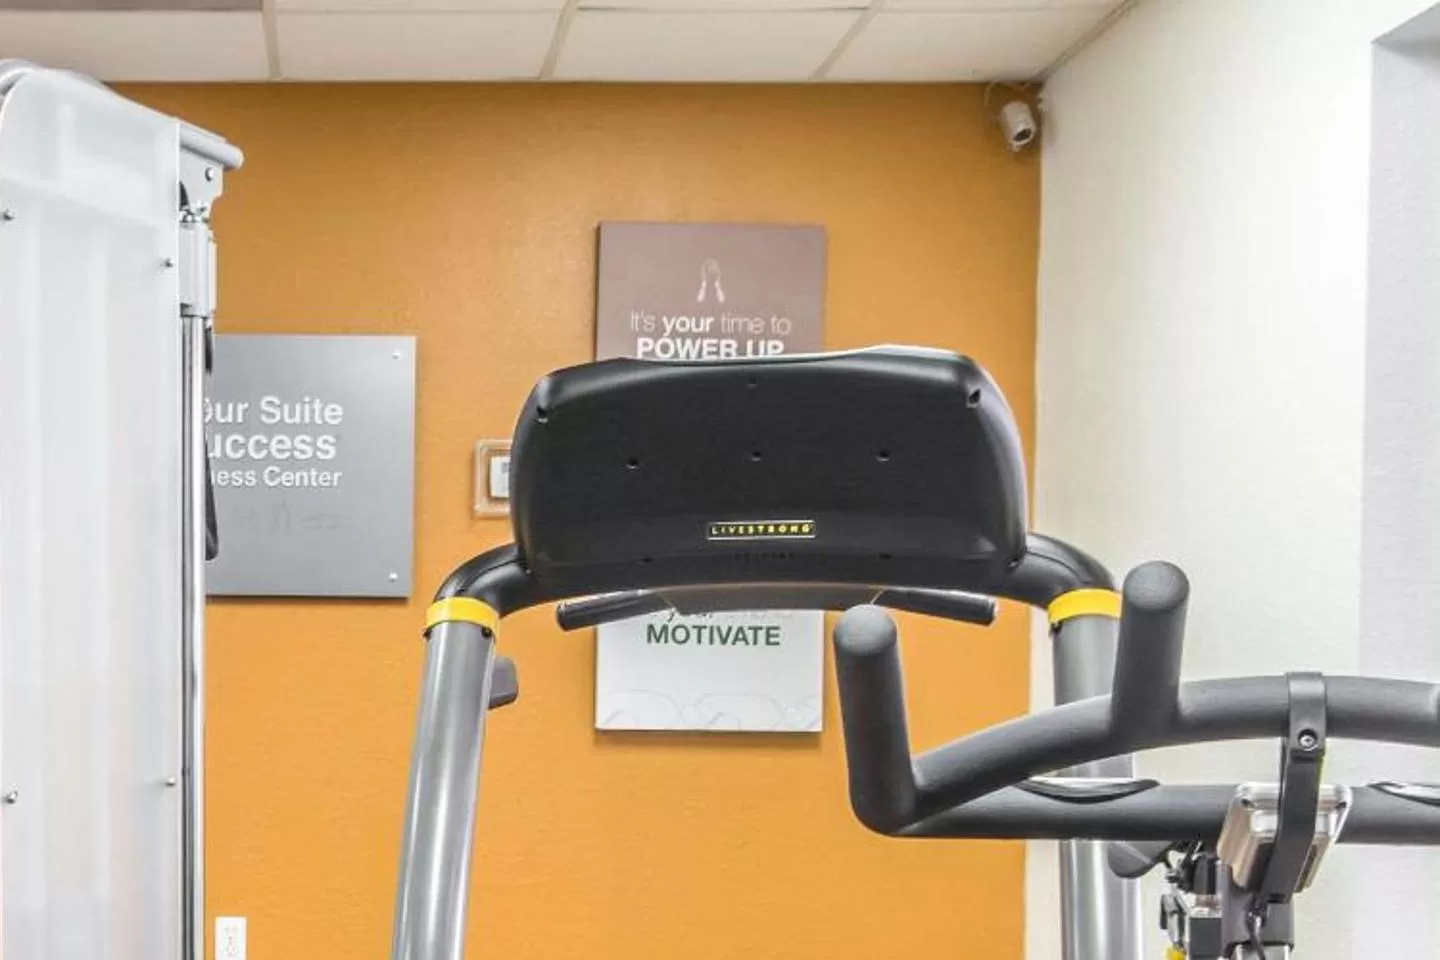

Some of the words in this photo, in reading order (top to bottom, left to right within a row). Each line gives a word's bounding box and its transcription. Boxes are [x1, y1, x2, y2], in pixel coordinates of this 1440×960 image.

[630, 310, 656, 333] It's
[662, 315, 715, 337] your
[720, 312, 766, 335] time
[771, 315, 793, 335] to
[636, 337, 739, 360] POWER
[746, 338, 785, 359] UP
[260, 395, 344, 425] Suite
[205, 432, 338, 460] uccess
[263, 465, 343, 487] Center
[711, 524, 810, 535] LIVESTRONG
[646, 623, 781, 646] MOTIVATE
